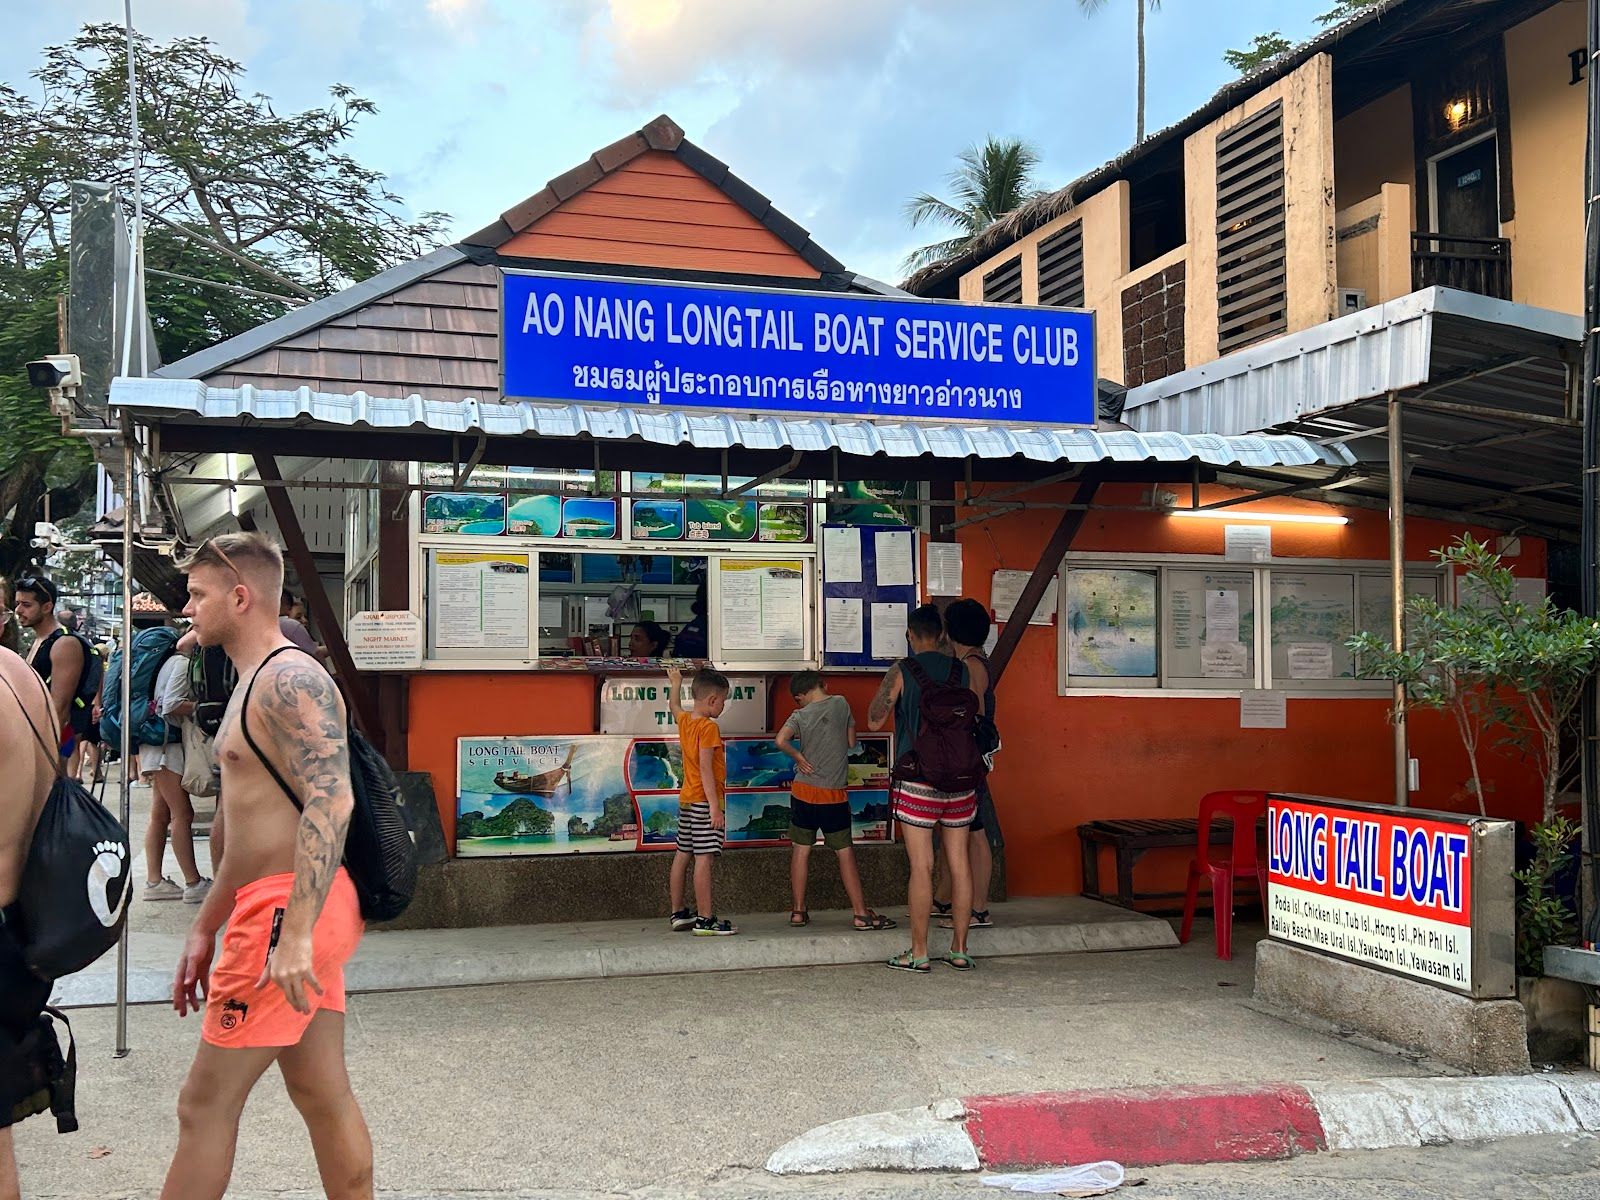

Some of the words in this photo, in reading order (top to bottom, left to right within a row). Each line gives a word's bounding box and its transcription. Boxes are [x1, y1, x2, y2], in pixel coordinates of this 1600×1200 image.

[522, 292, 564, 336] AO
[575, 295, 654, 342] NANG
[814, 312, 884, 356] BOAT
[895, 317, 1003, 362] SERVICE
[1013, 324, 1078, 366] CLUB
[572, 359, 1022, 409] ชมรมผู้ประกอบการเรือหางยาวอ่าวนาง
[612, 686, 657, 701] LONG
[469, 746, 499, 757] LONG
[503, 746, 525, 756] TAIL
[530, 745, 560, 755] BOAT
[1269, 808, 1327, 884] LONG
[1333, 817, 1385, 896] TAIL
[1391, 825, 1468, 913] BOAT
[1271, 914, 1290, 938] Railay
[1453, 962, 1467, 983] Isl.
[1275, 894, 1290, 912] Poda
[1445, 934, 1459, 954] Isl.
